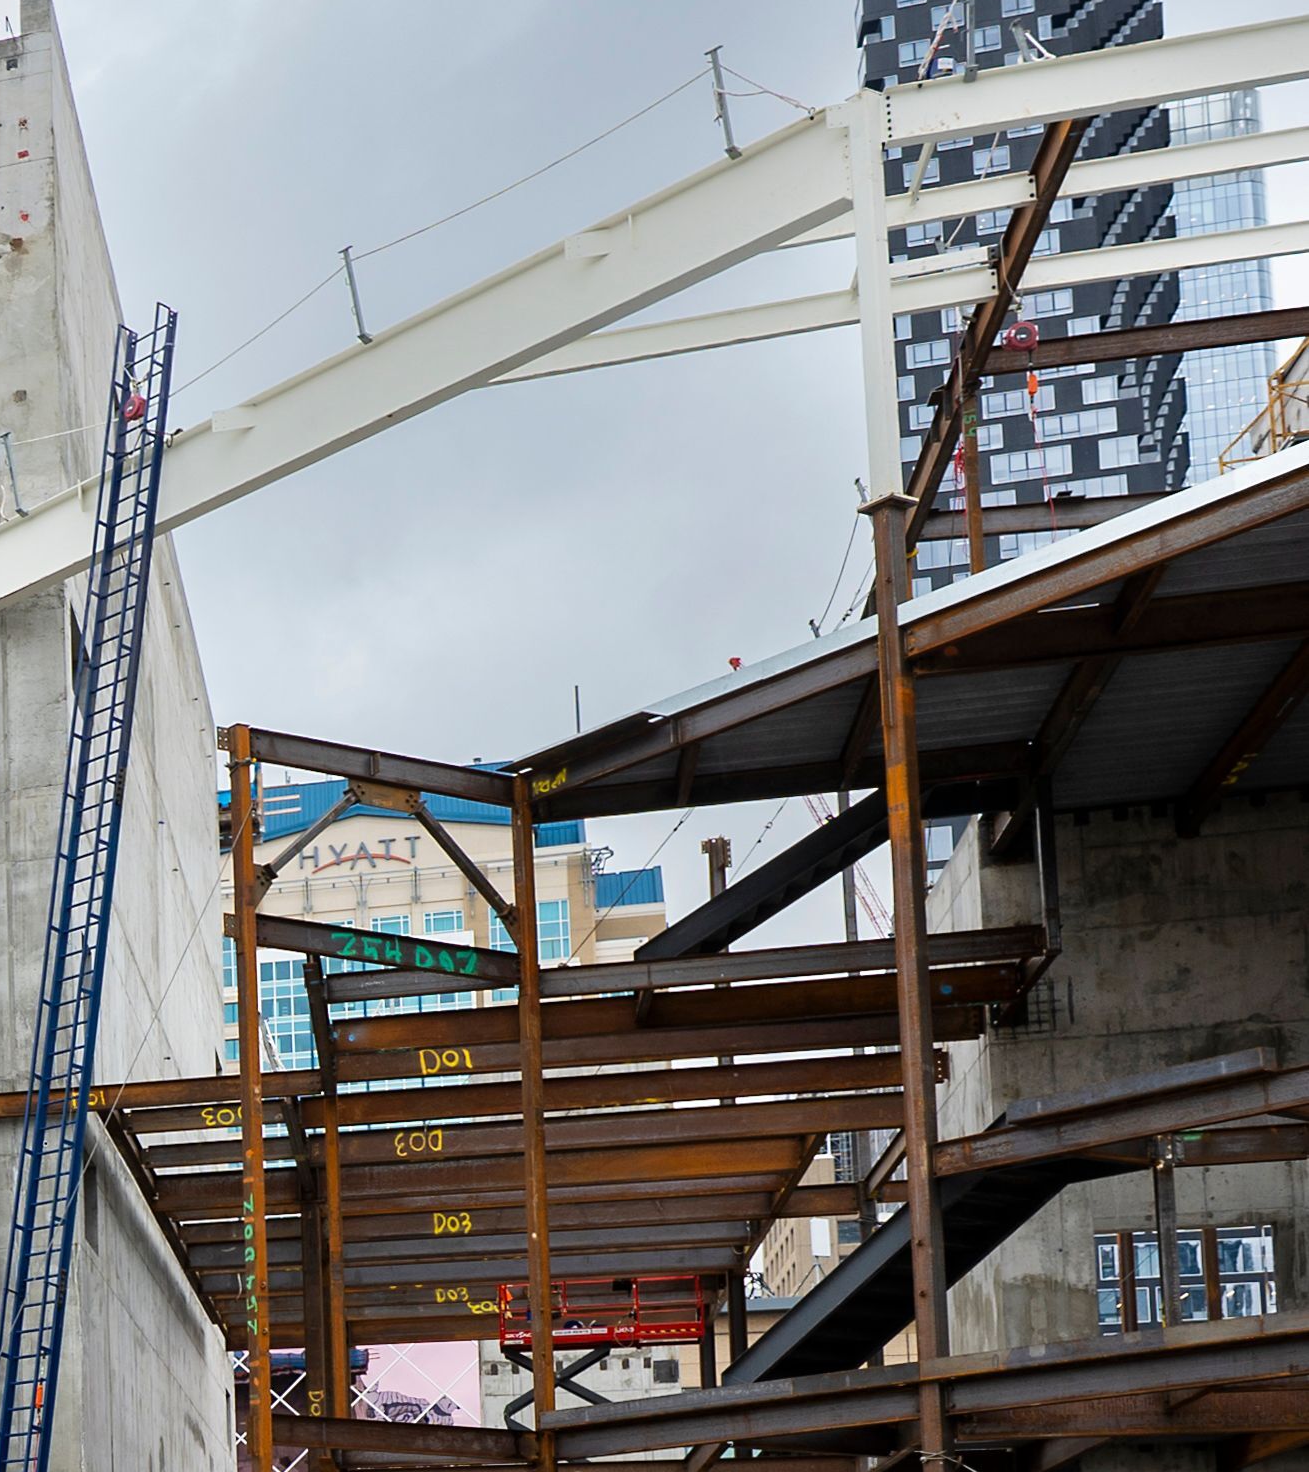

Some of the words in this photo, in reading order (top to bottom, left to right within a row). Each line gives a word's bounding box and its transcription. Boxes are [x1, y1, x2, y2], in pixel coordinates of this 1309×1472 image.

[300, 836, 420, 870] HYATT
[419, 1049, 472, 1075] D01
[433, 1212, 472, 1234] D03
[435, 1286, 469, 1303] D03
